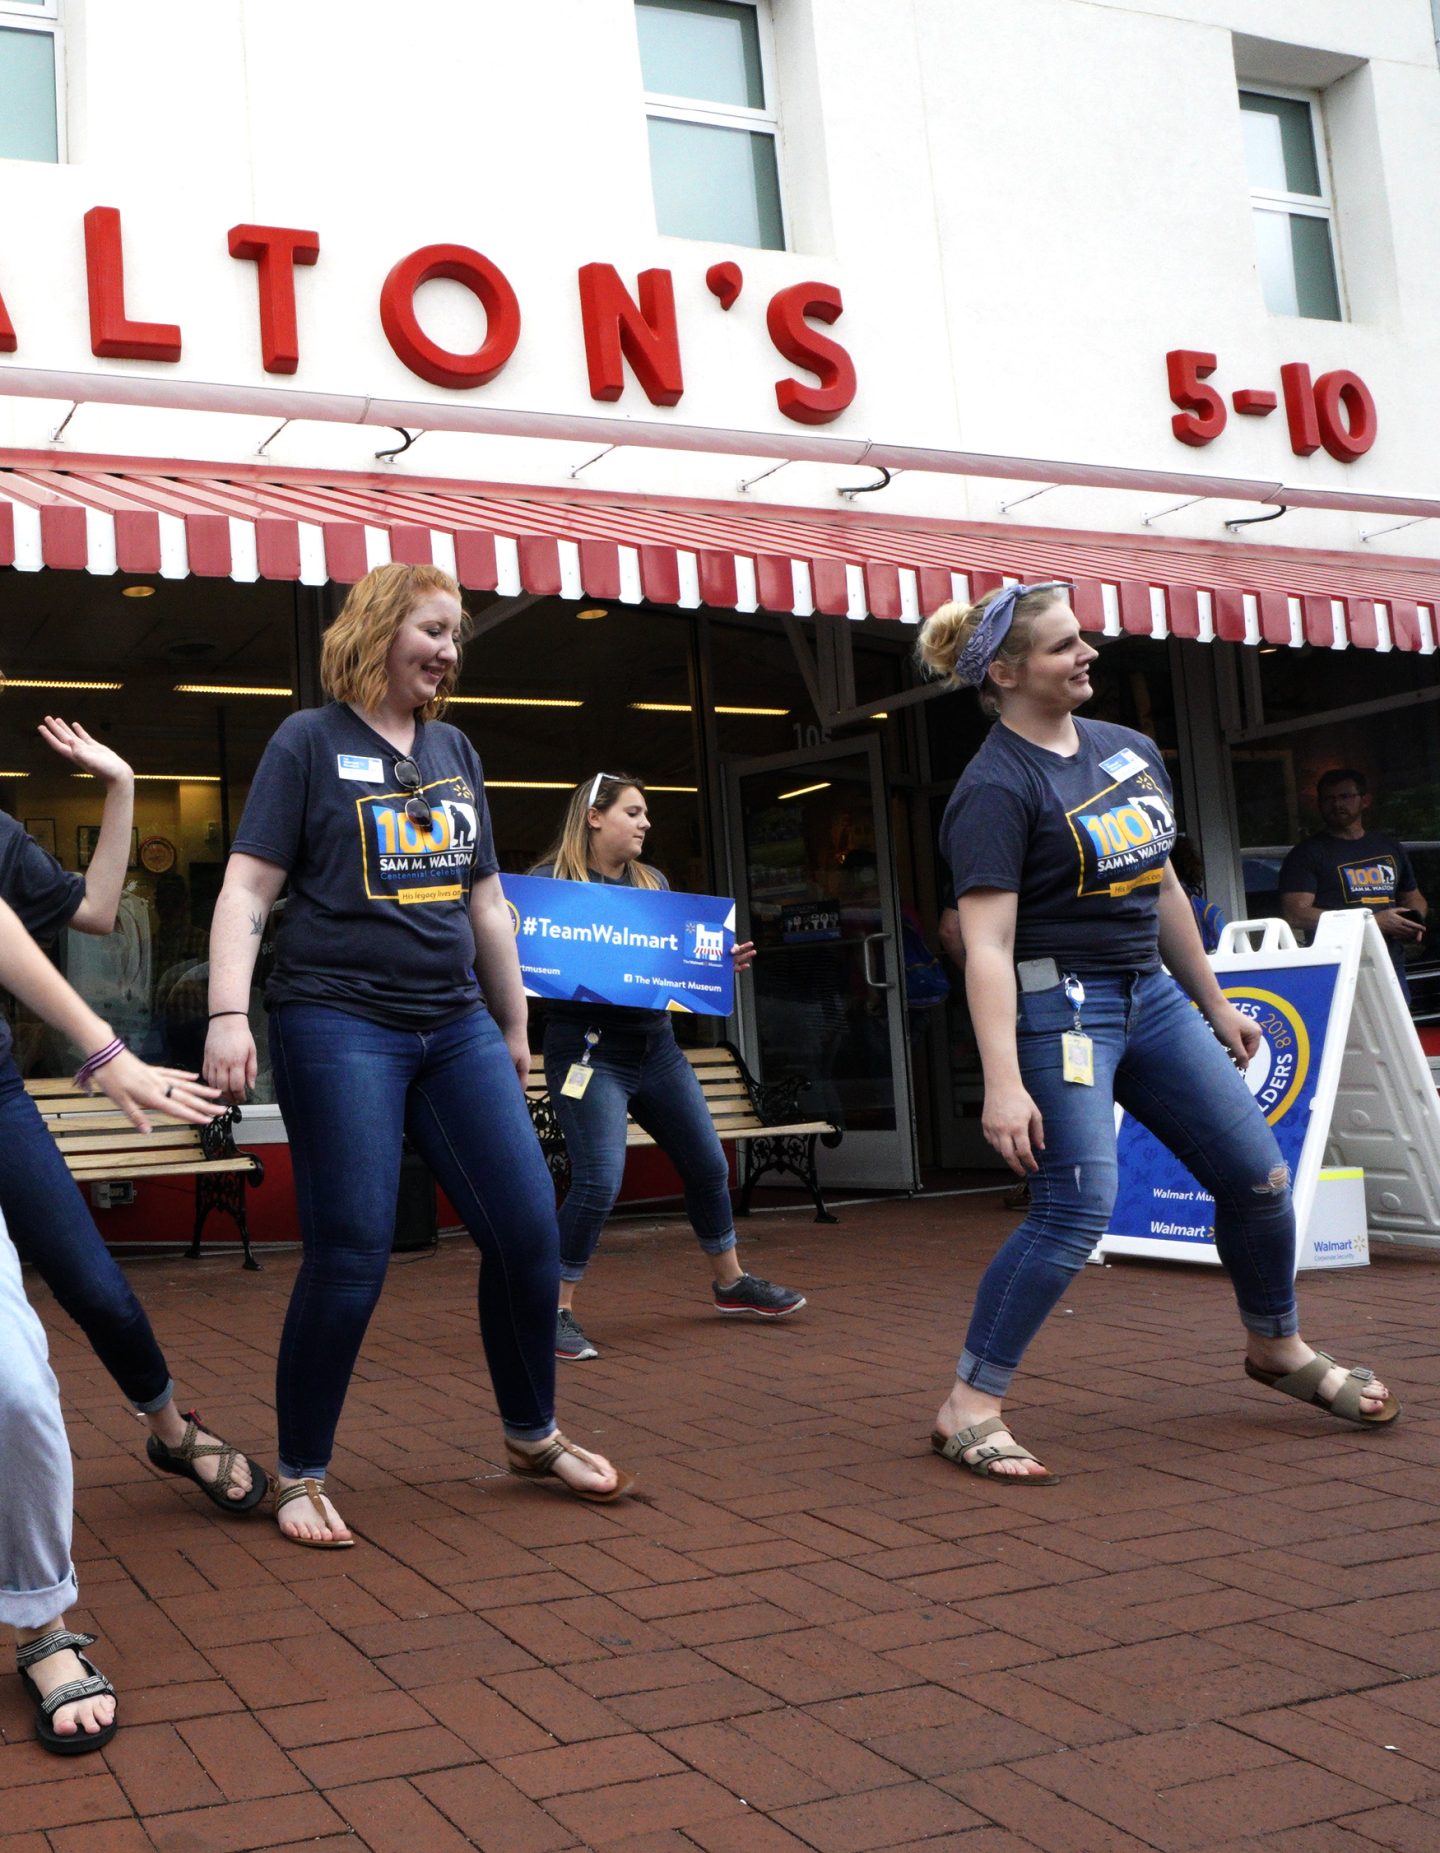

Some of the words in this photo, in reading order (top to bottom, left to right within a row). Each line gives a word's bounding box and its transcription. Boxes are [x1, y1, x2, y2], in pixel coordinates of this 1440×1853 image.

[1166, 349, 1378, 463] 5-10
[377, 810, 450, 855] 100
[1087, 807, 1154, 856] 100
[380, 858, 408, 872] SAM
[411, 858, 427, 870] M.
[429, 853, 472, 868] WALTON
[1097, 856, 1124, 872] SAM
[1123, 852, 1139, 865] M.
[1346, 867, 1383, 885] 100
[415, 890, 437, 900] legacy
[437, 889, 451, 898] lives
[522, 916, 679, 951] #TeamWalmart
[635, 975, 651, 985] The
[652, 976, 686, 989] Walmart
[687, 981, 722, 992] Museum
[1261, 1013, 1292, 1049] 2018
[1152, 1188, 1193, 1200] Walmart
[1150, 1221, 1205, 1238] Walmart
[1313, 1240, 1352, 1252] Walmart
